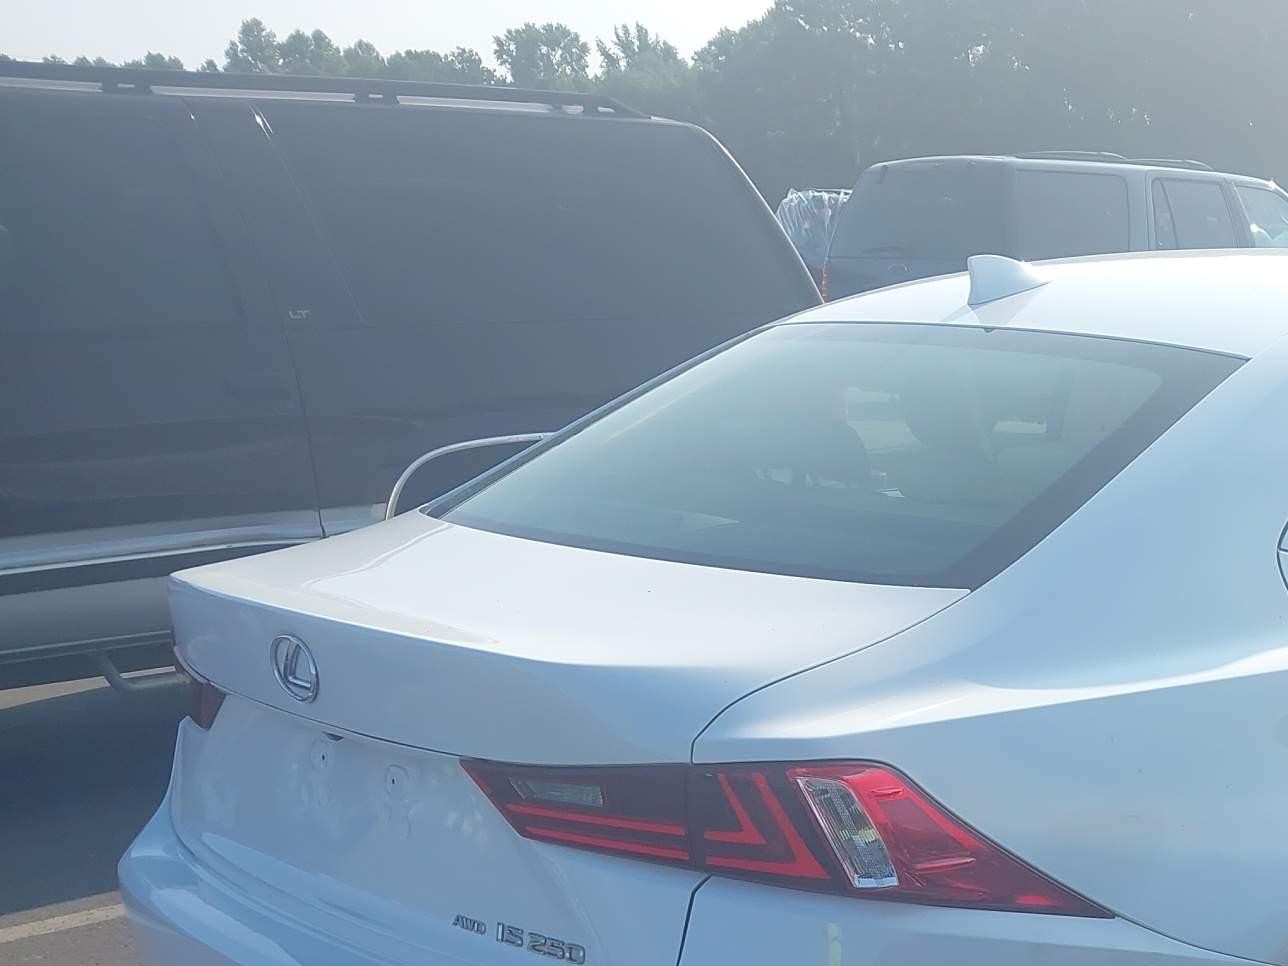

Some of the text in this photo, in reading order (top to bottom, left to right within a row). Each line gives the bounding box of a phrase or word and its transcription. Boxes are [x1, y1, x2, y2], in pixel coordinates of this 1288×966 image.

[288, 310, 310, 322] LT
[453, 915, 586, 966] AWD IS 250
